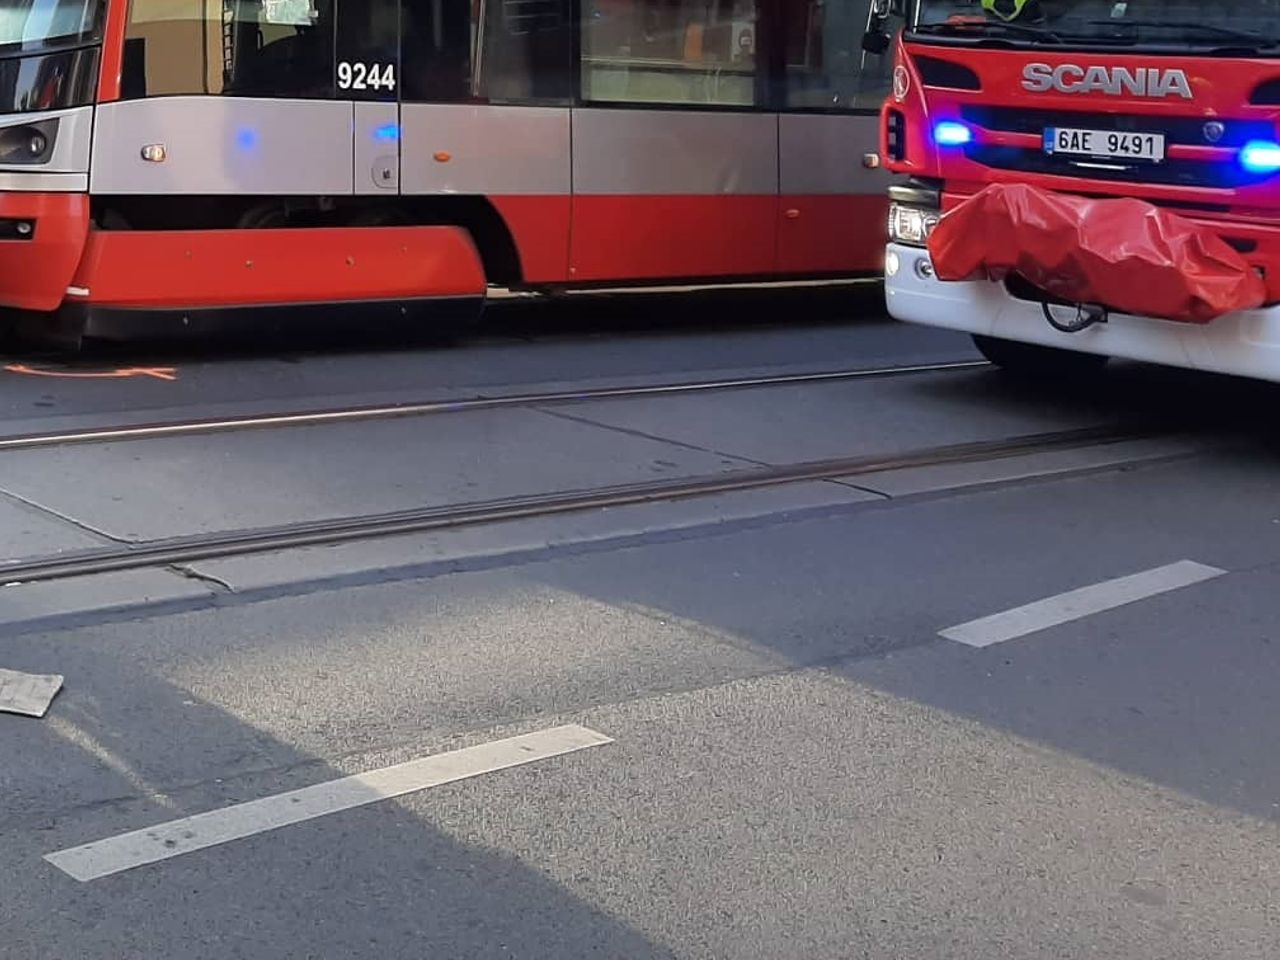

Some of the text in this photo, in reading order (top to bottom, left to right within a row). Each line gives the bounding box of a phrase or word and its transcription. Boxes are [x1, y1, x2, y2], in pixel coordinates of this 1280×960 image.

[338, 62, 396, 91] 9244
[1022, 62, 1193, 99] SCANIA
[1058, 130, 1092, 152] 6AE
[1107, 133, 1154, 155] 9491
